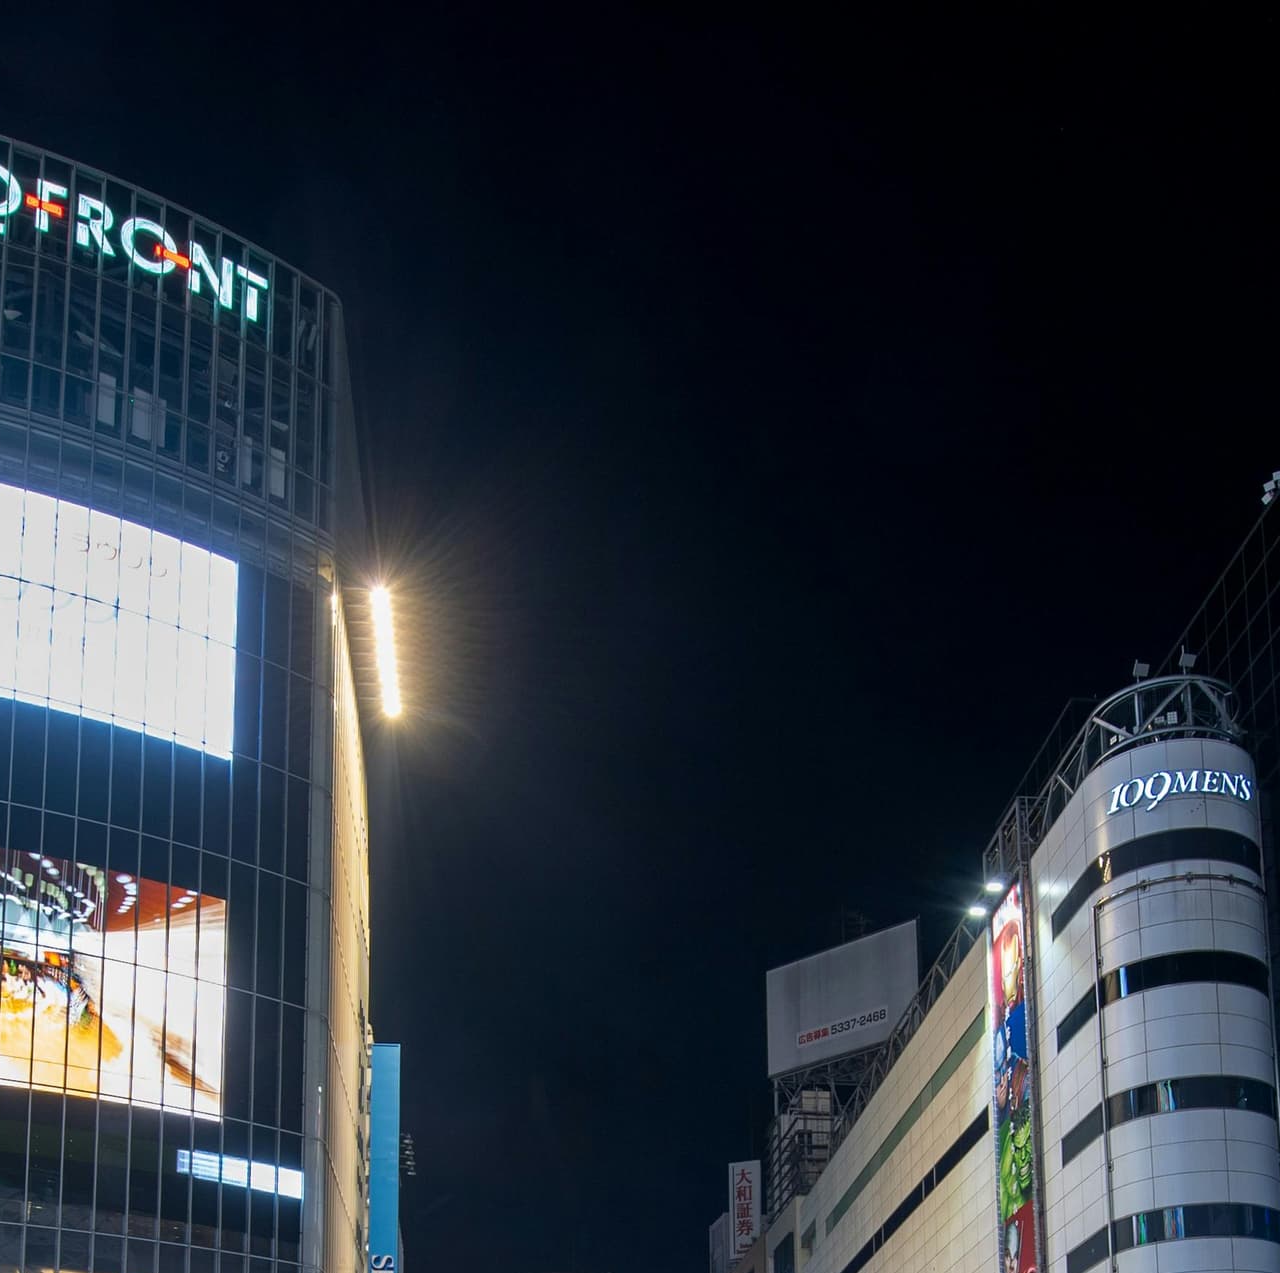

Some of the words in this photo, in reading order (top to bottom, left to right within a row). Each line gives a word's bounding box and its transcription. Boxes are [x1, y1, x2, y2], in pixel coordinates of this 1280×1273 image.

[830, 1008, 887, 1036] 5337-2468
[736, 1169, 753, 1236] 大和証券
